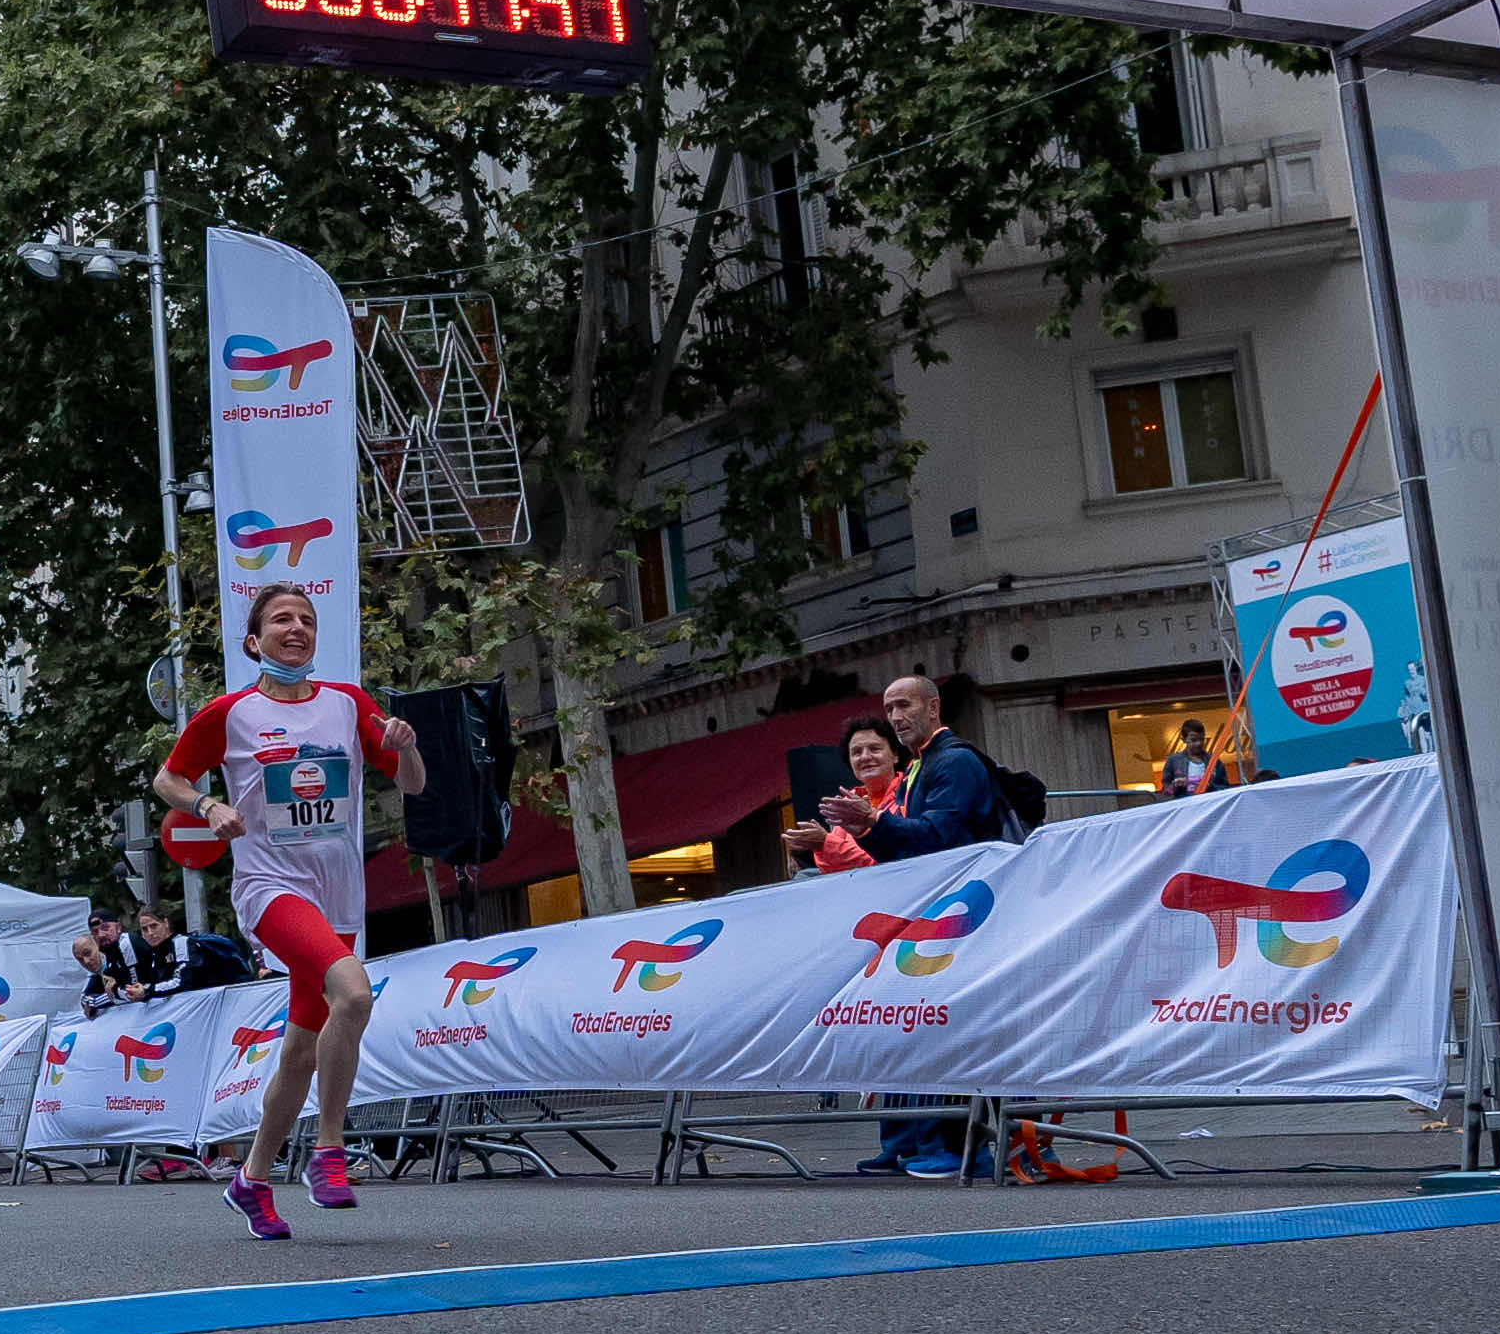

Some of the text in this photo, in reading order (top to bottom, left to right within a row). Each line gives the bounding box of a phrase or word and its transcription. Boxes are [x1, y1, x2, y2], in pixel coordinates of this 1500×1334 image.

[1311, 679, 1341, 693] MILLA
[1305, 699, 1355, 717] DE MADRID
[287, 799, 335, 827] 1012
[571, 1008, 673, 1038] TotalEnergies
[1151, 993, 1352, 1034] TotalEnergies
[105, 1095, 166, 1116] TotalEnergies
